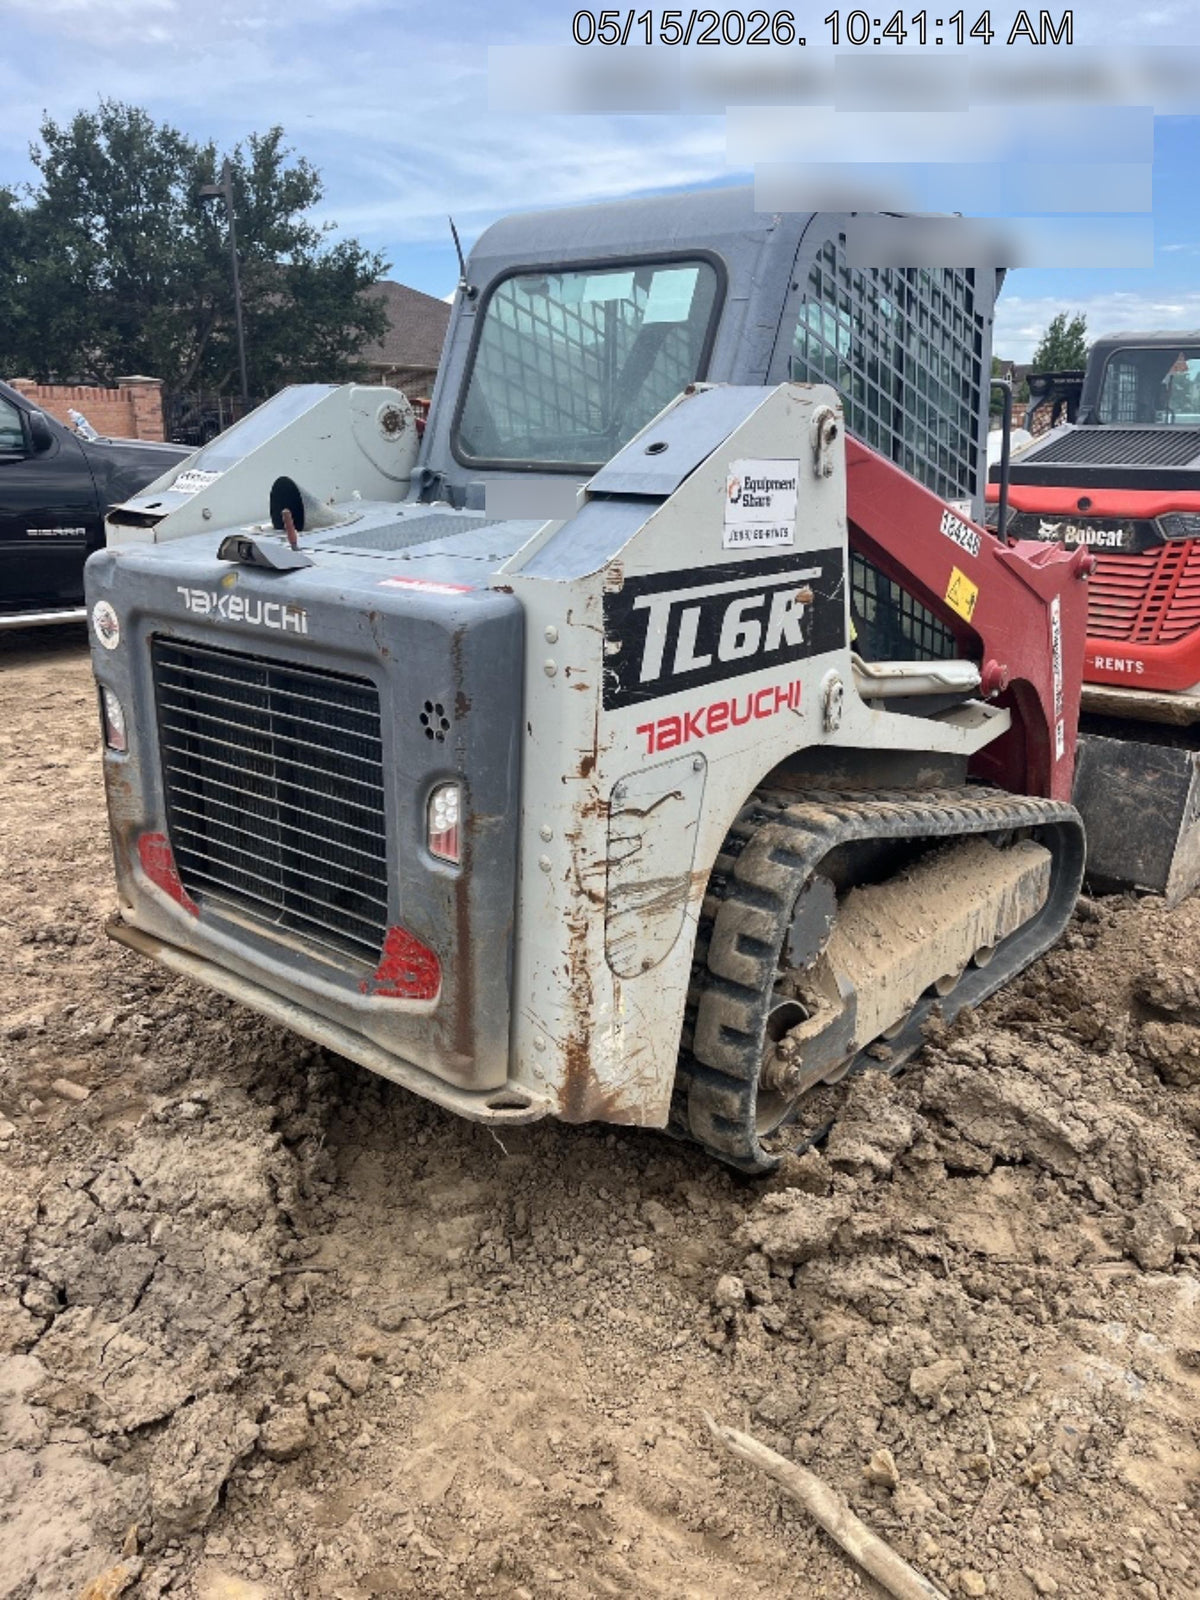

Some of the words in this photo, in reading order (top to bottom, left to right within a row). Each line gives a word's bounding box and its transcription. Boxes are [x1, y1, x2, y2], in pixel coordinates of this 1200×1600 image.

[743, 476, 795, 493] Equipment
[742, 493, 772, 508] Share
[1064, 525, 1123, 547] Bobcat
[632, 566, 823, 684] TL6R
